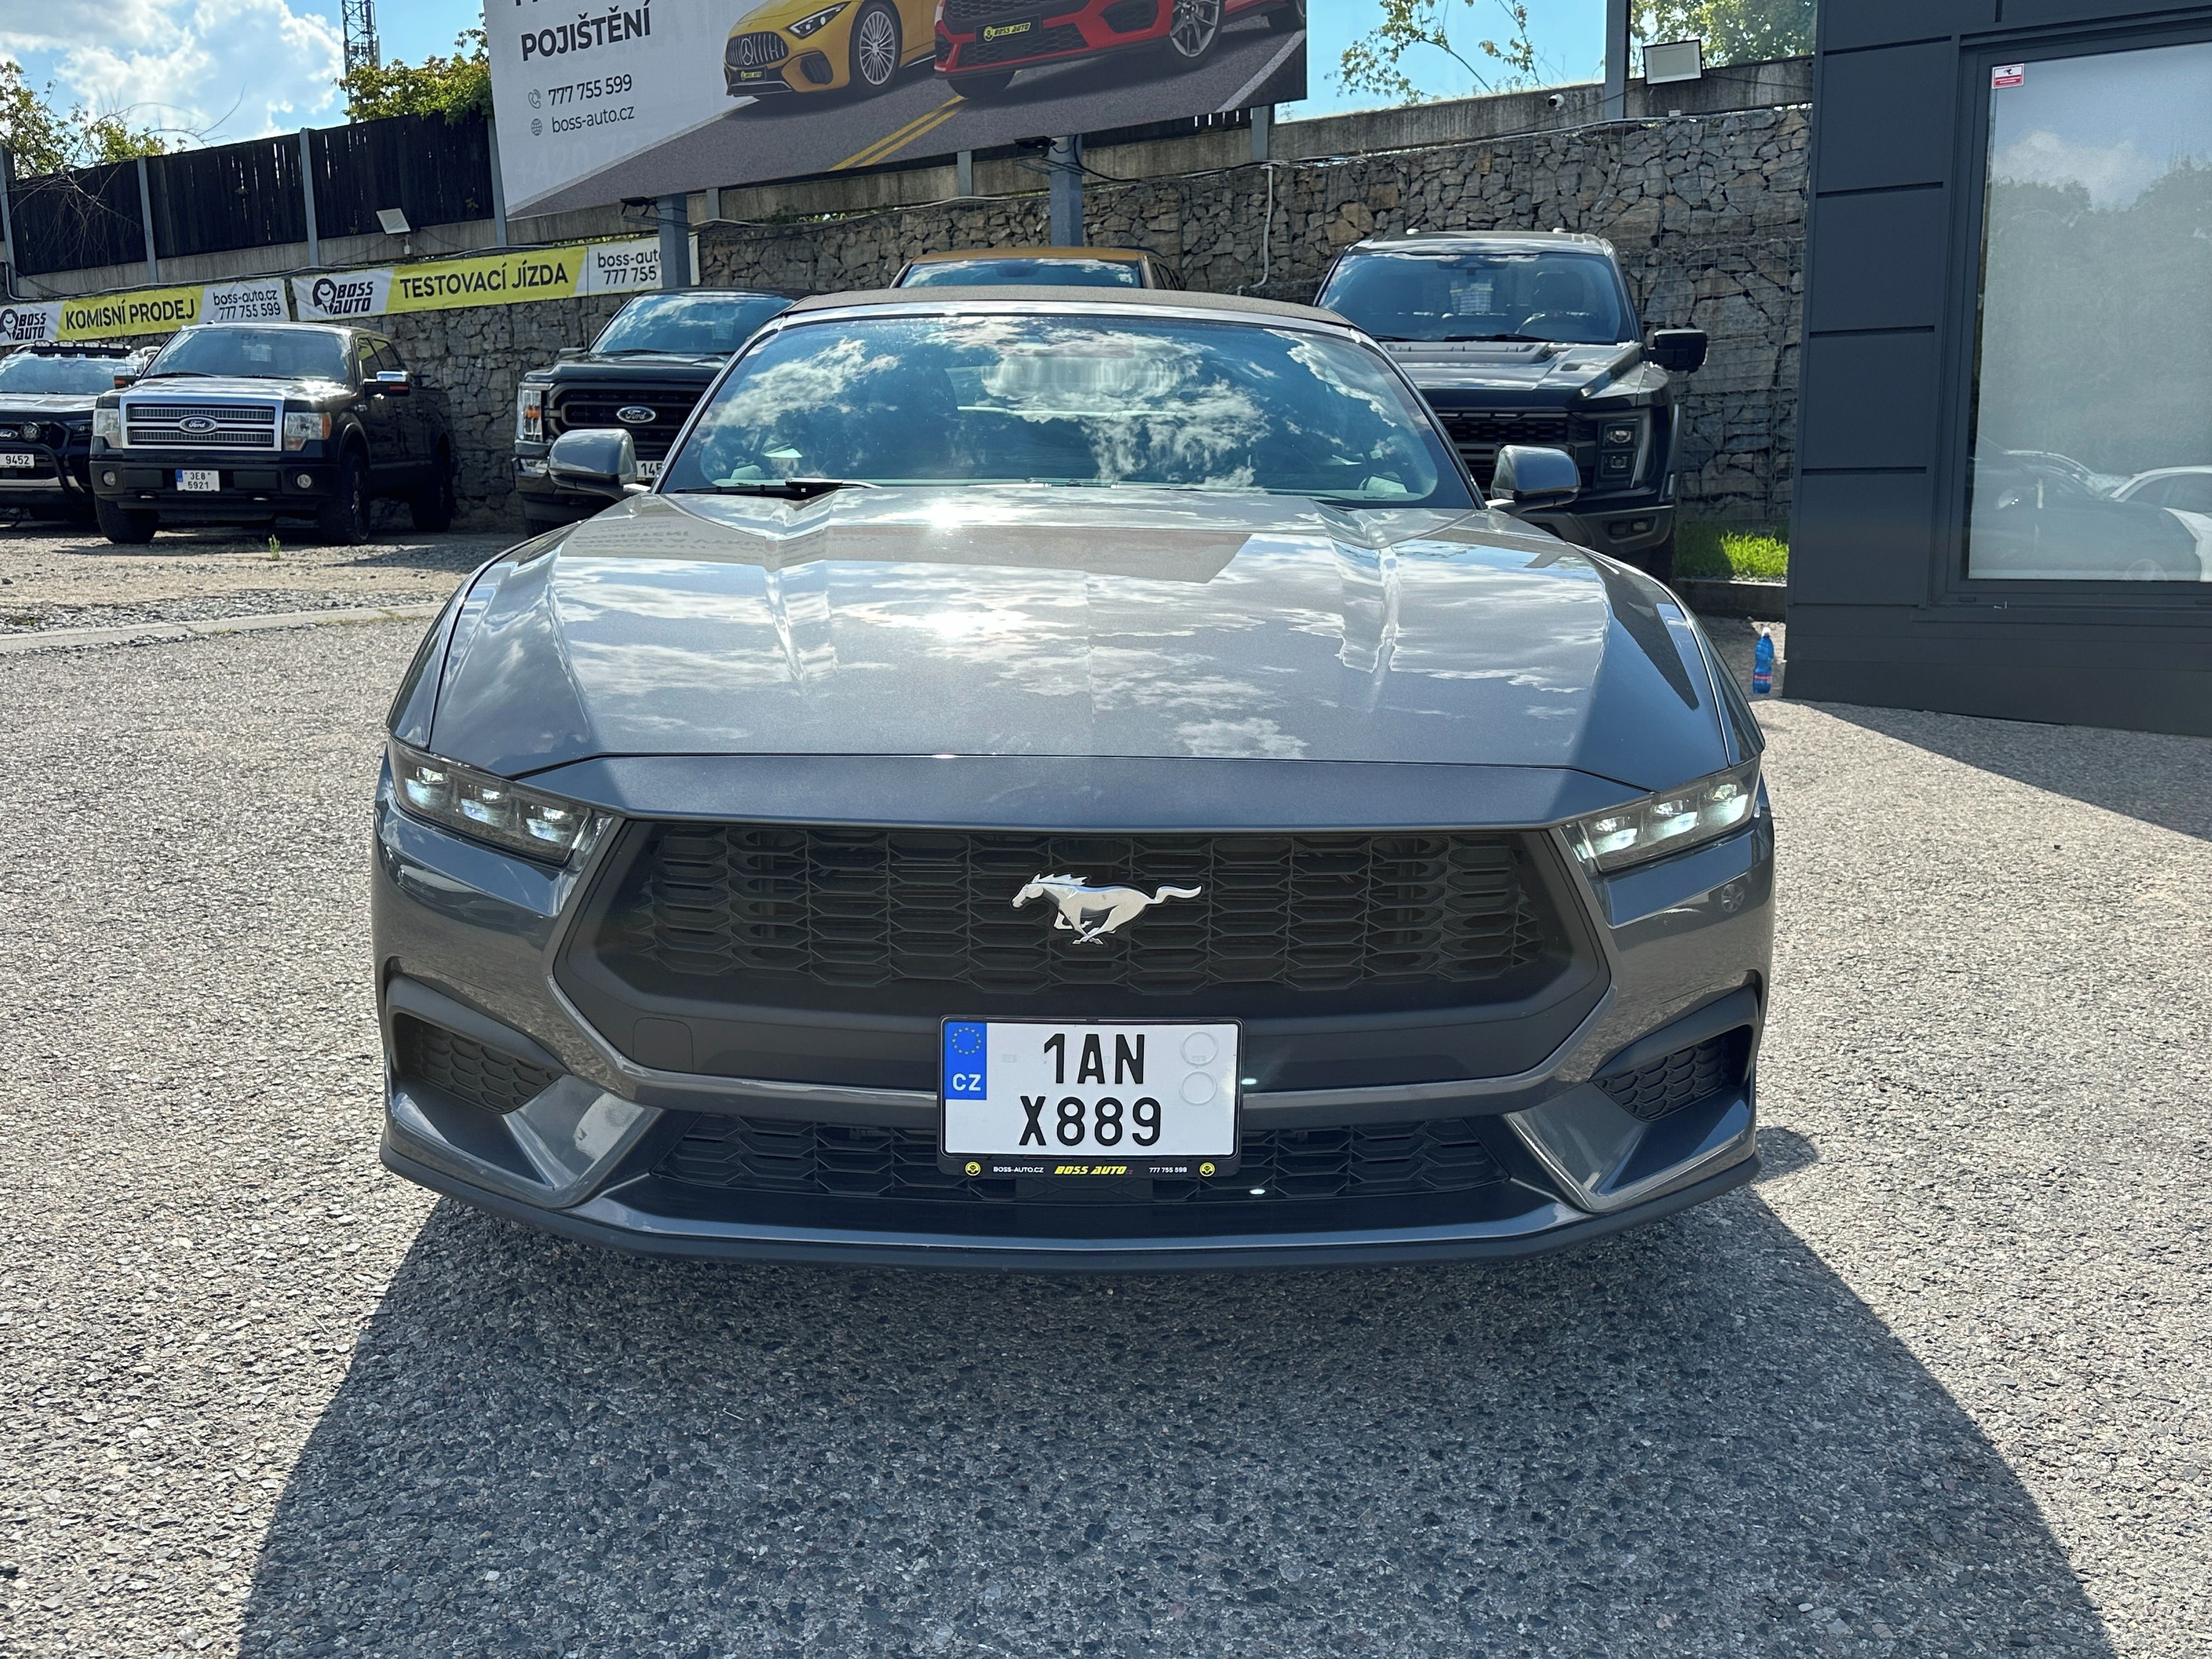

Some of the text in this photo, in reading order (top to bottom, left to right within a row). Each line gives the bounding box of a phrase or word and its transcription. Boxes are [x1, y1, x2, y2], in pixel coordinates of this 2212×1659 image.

[521, 0, 650, 61] POJIŠTĚNÍ
[549, 74, 632, 105] 777 755 599
[552, 106, 634, 133] boss-auto.cz
[597, 249, 661, 268] boss-aut
[399, 259, 568, 298] TESTOVACÍ JÍZDA
[603, 266, 657, 285] 777 755
[213, 290, 277, 306] boss-auto.cz
[337, 281, 373, 299] BOSS
[66, 298, 195, 330] KOMISNÍ PRODEJ
[219, 303, 281, 320] 777 755 599
[332, 297, 371, 315] AUTO
[19, 312, 46, 326] BOSS
[15, 326, 45, 340] AUTO
[625, 409, 646, 420] Ford
[5, 455, 30, 465] 9452
[188, 481, 208, 489] 5921
[1044, 1034, 1145, 1084] 1AN
[952, 1073, 981, 1091] CZ
[1019, 1096, 1161, 1146] X889
[1054, 1166, 1089, 1175] BOSS
[1090, 1166, 1127, 1175] AUTO
